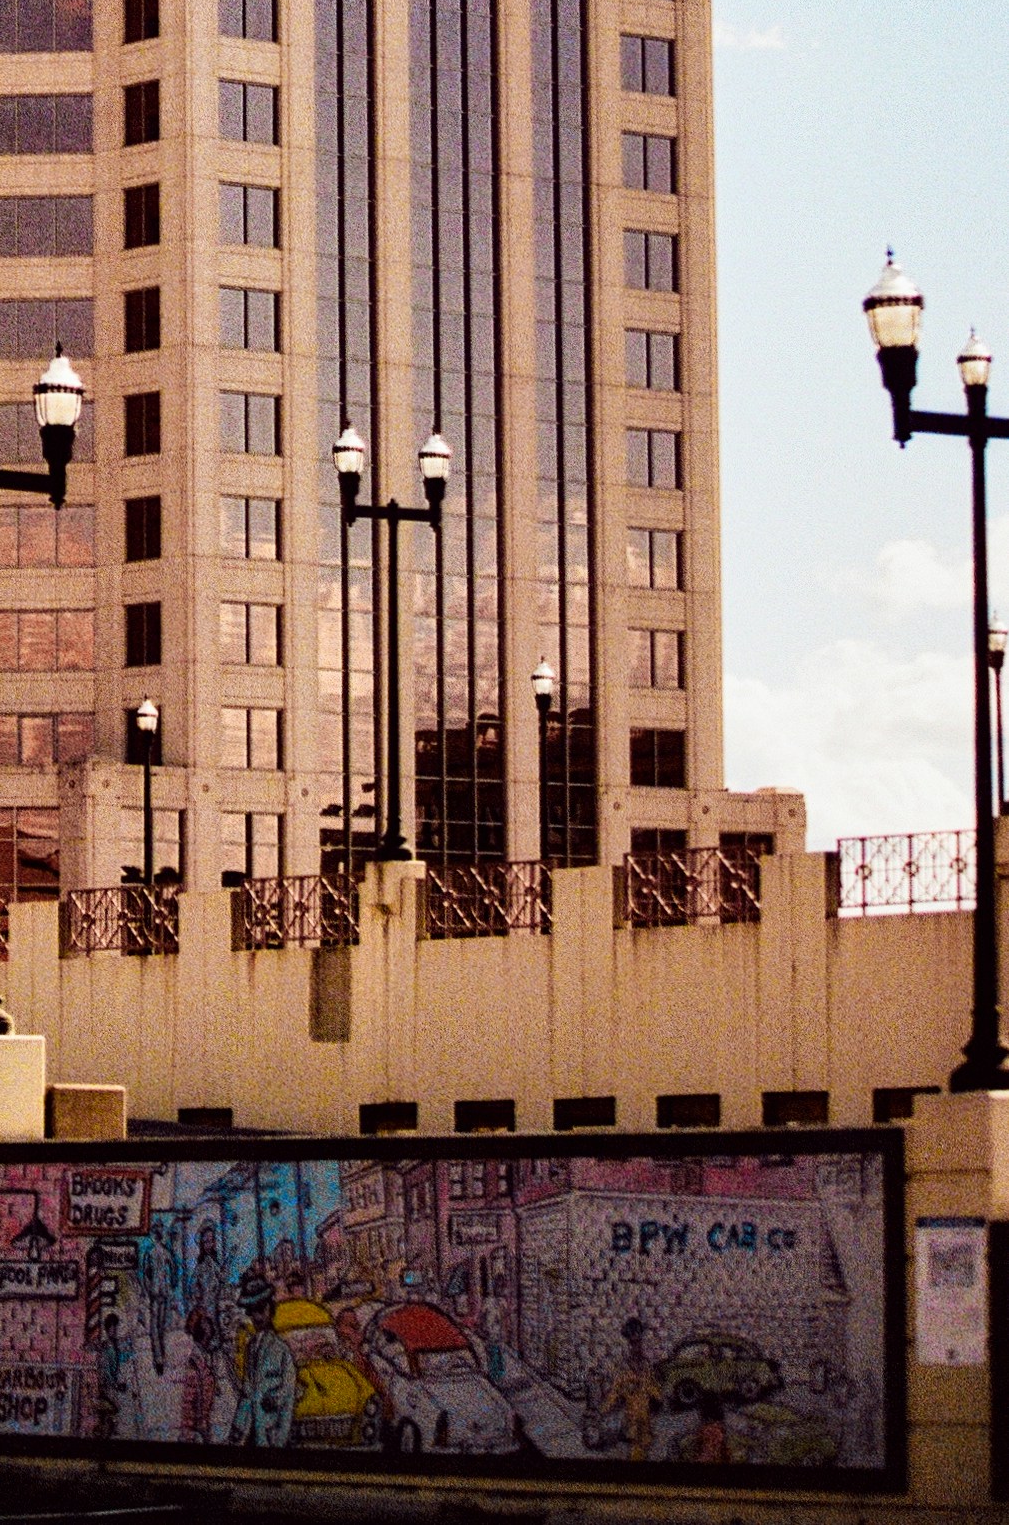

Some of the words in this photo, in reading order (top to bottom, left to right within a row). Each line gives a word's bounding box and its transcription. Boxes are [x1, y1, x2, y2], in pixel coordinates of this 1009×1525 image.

[72, 1174, 136, 1197] BROOKS
[71, 1204, 128, 1226] DRUGS
[708, 1223, 756, 1252] CAB
